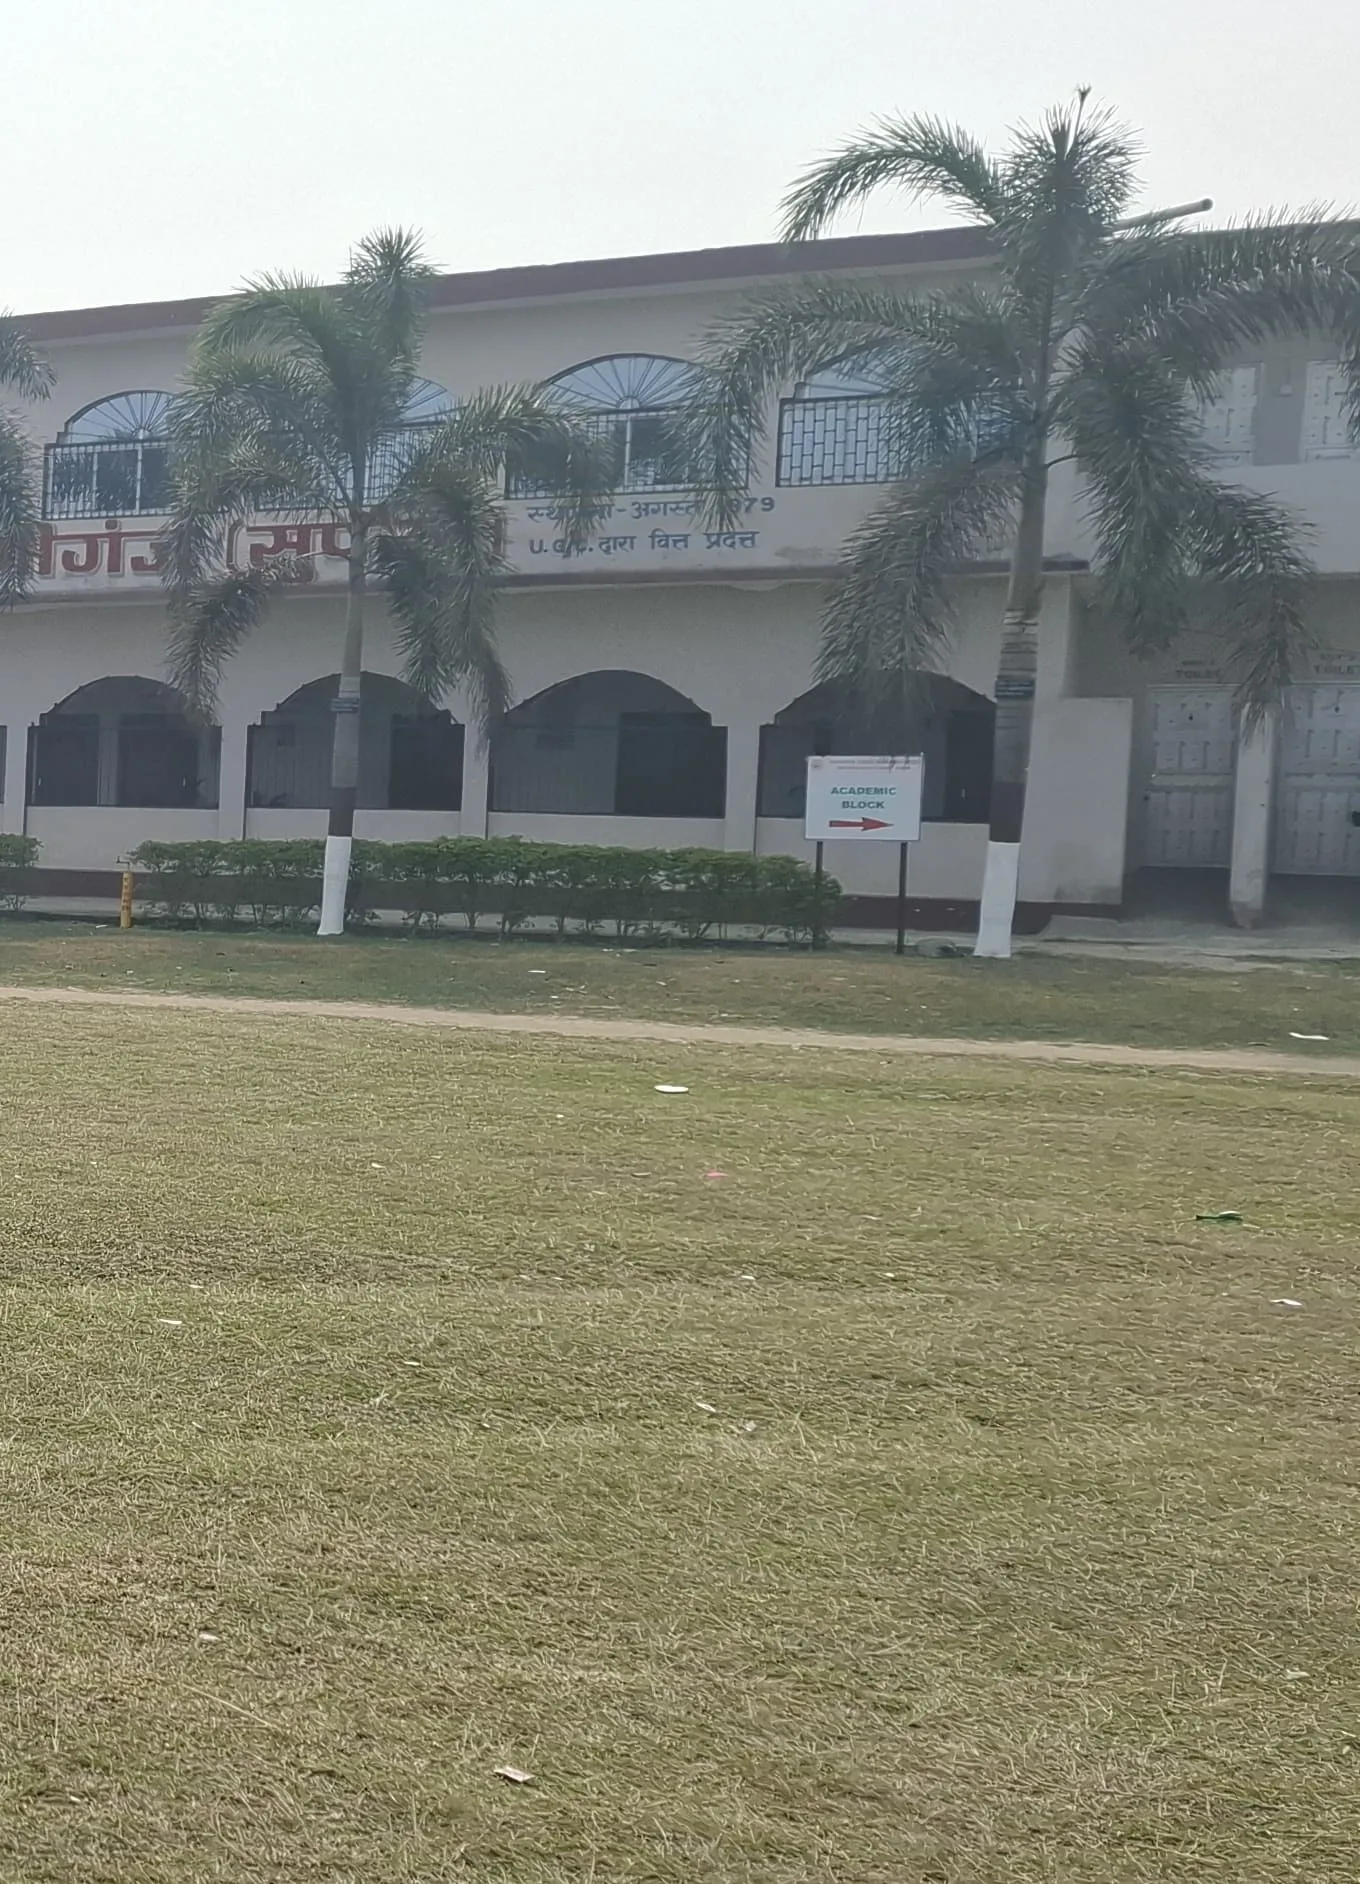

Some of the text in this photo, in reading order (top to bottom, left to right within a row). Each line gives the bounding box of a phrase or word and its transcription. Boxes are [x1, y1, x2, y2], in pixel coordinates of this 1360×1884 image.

[724, 496, 776, 514] 979
[830, 786, 898, 797] ACADEMIC
[841, 800, 886, 810] BLOCK
